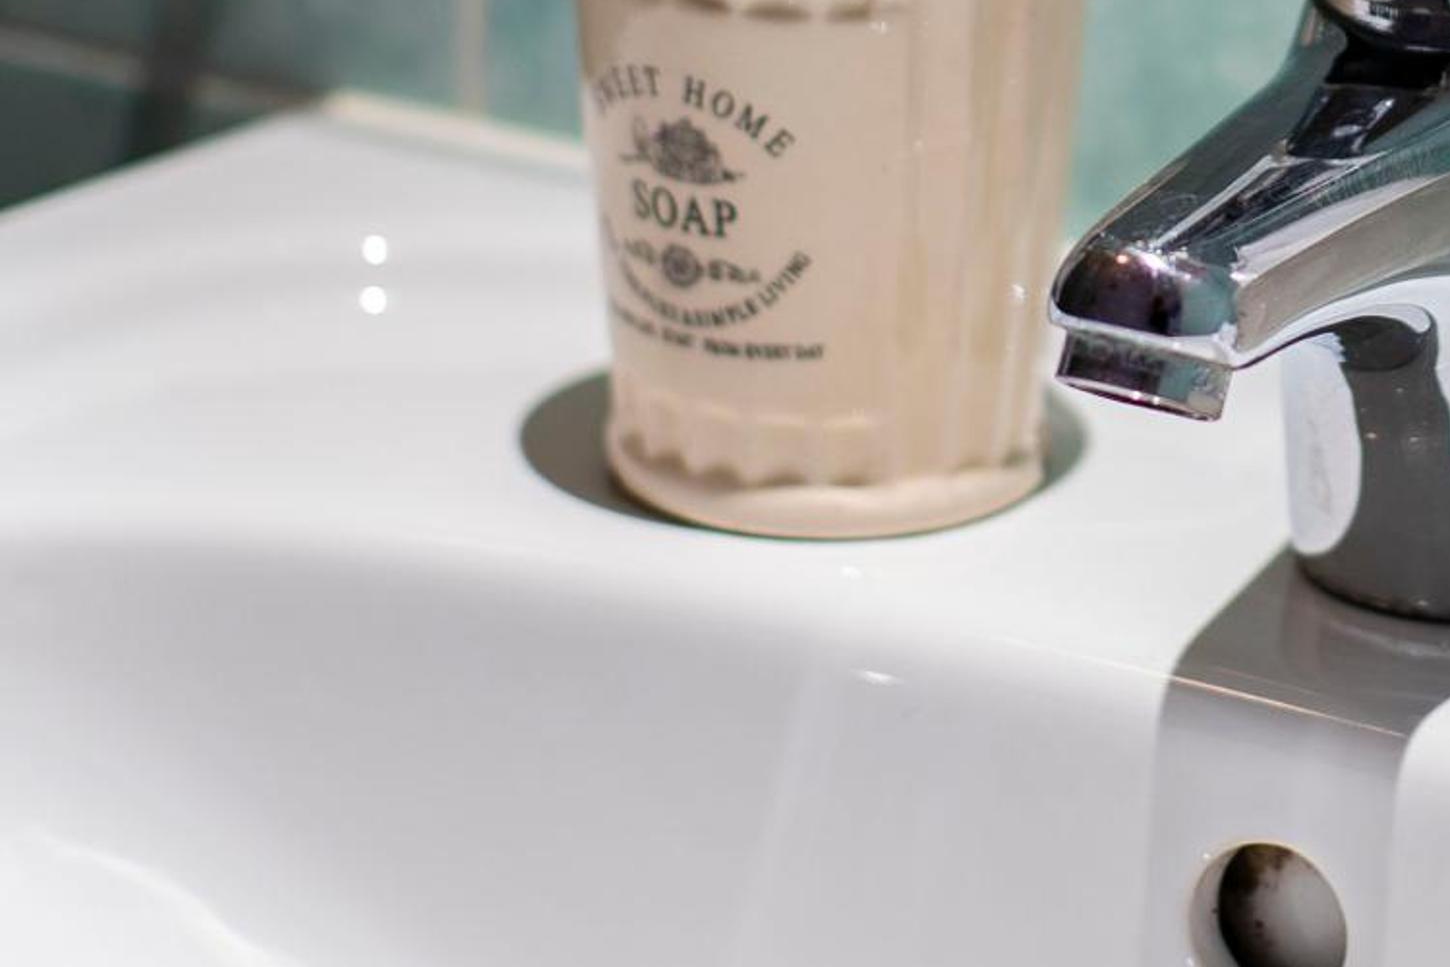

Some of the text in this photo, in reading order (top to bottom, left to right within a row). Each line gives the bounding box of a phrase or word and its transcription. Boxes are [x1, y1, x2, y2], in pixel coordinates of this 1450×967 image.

[683, 75, 796, 159] HOME
[632, 177, 738, 238] SOAP
[757, 250, 812, 309] LIVING
